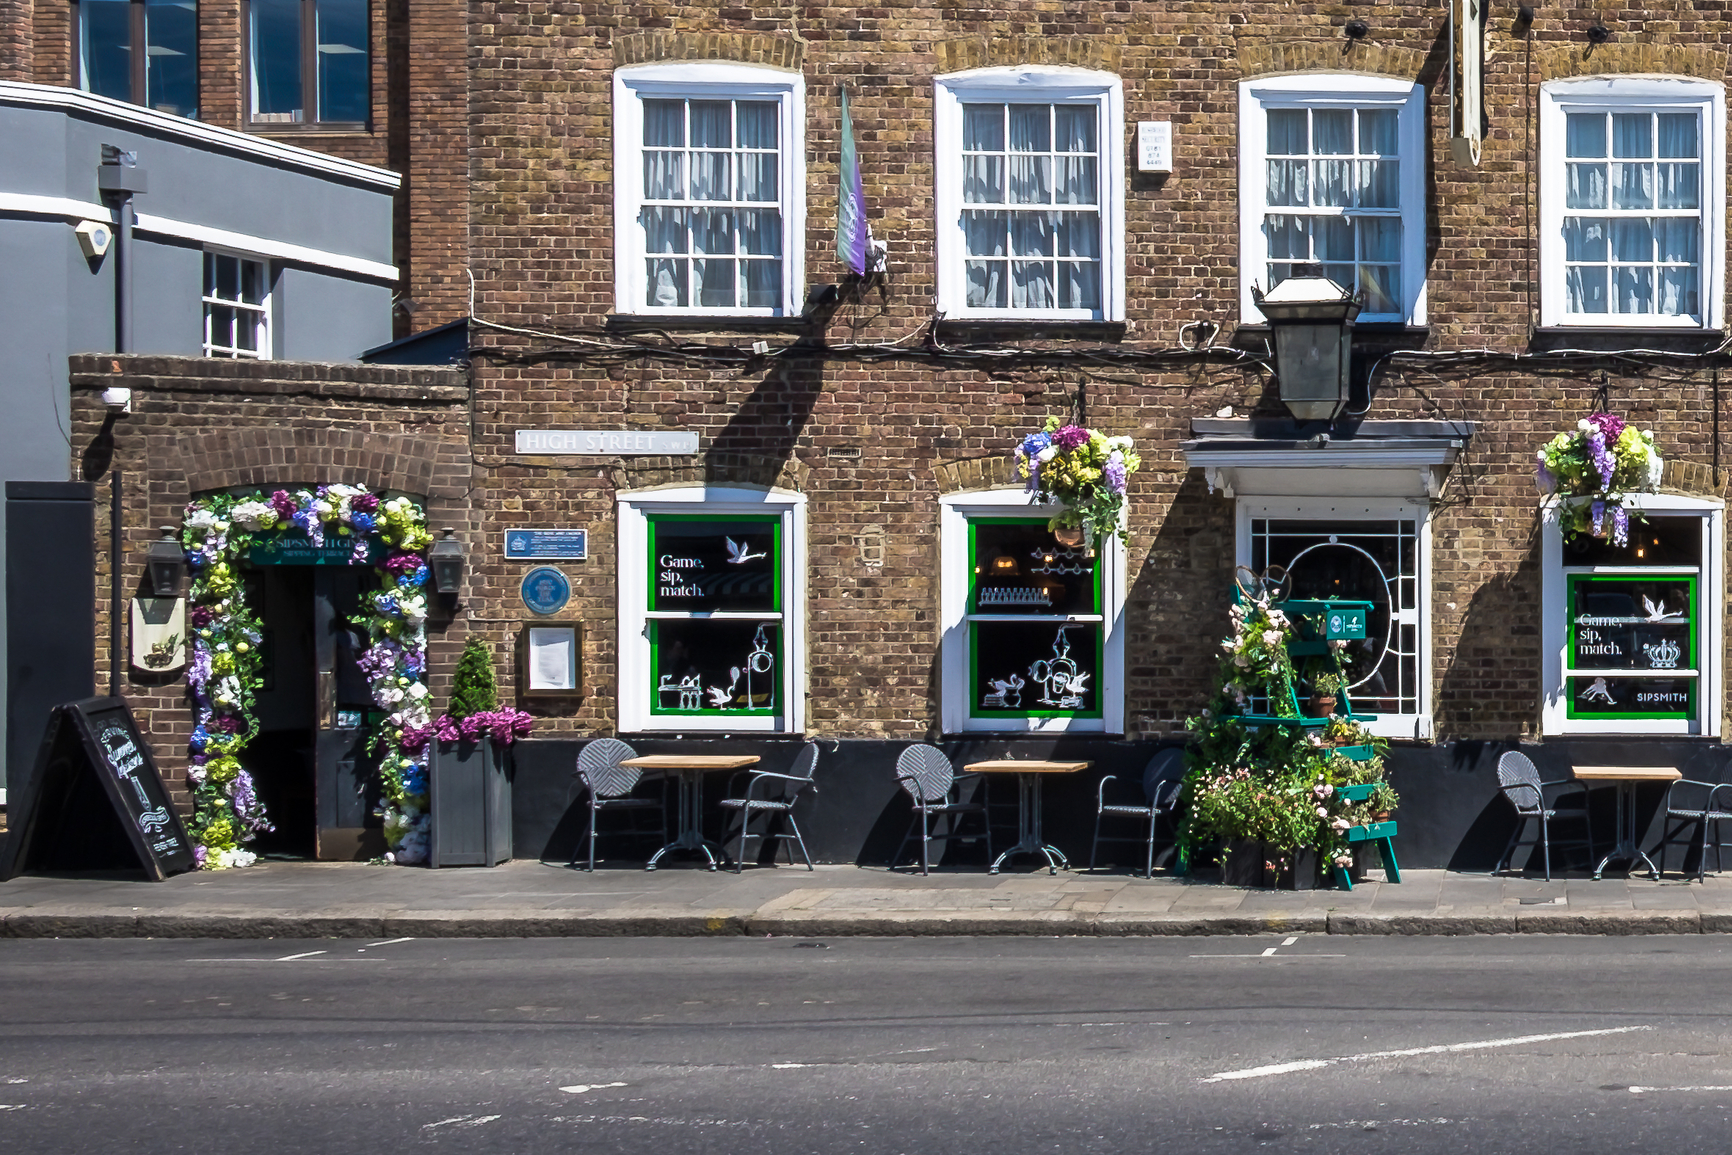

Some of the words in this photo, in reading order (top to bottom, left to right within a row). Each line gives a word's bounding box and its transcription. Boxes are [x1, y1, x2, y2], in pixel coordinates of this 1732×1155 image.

[525, 434, 577, 450] HIGH
[586, 434, 657, 451] STREET
[660, 554, 704, 569] Game,
[660, 569, 684, 586] sip,
[660, 583, 705, 596] match.
[1580, 613, 1623, 628] Game,
[1580, 641, 1623, 655] match.
[1636, 692, 1687, 702] SIPSMITH
